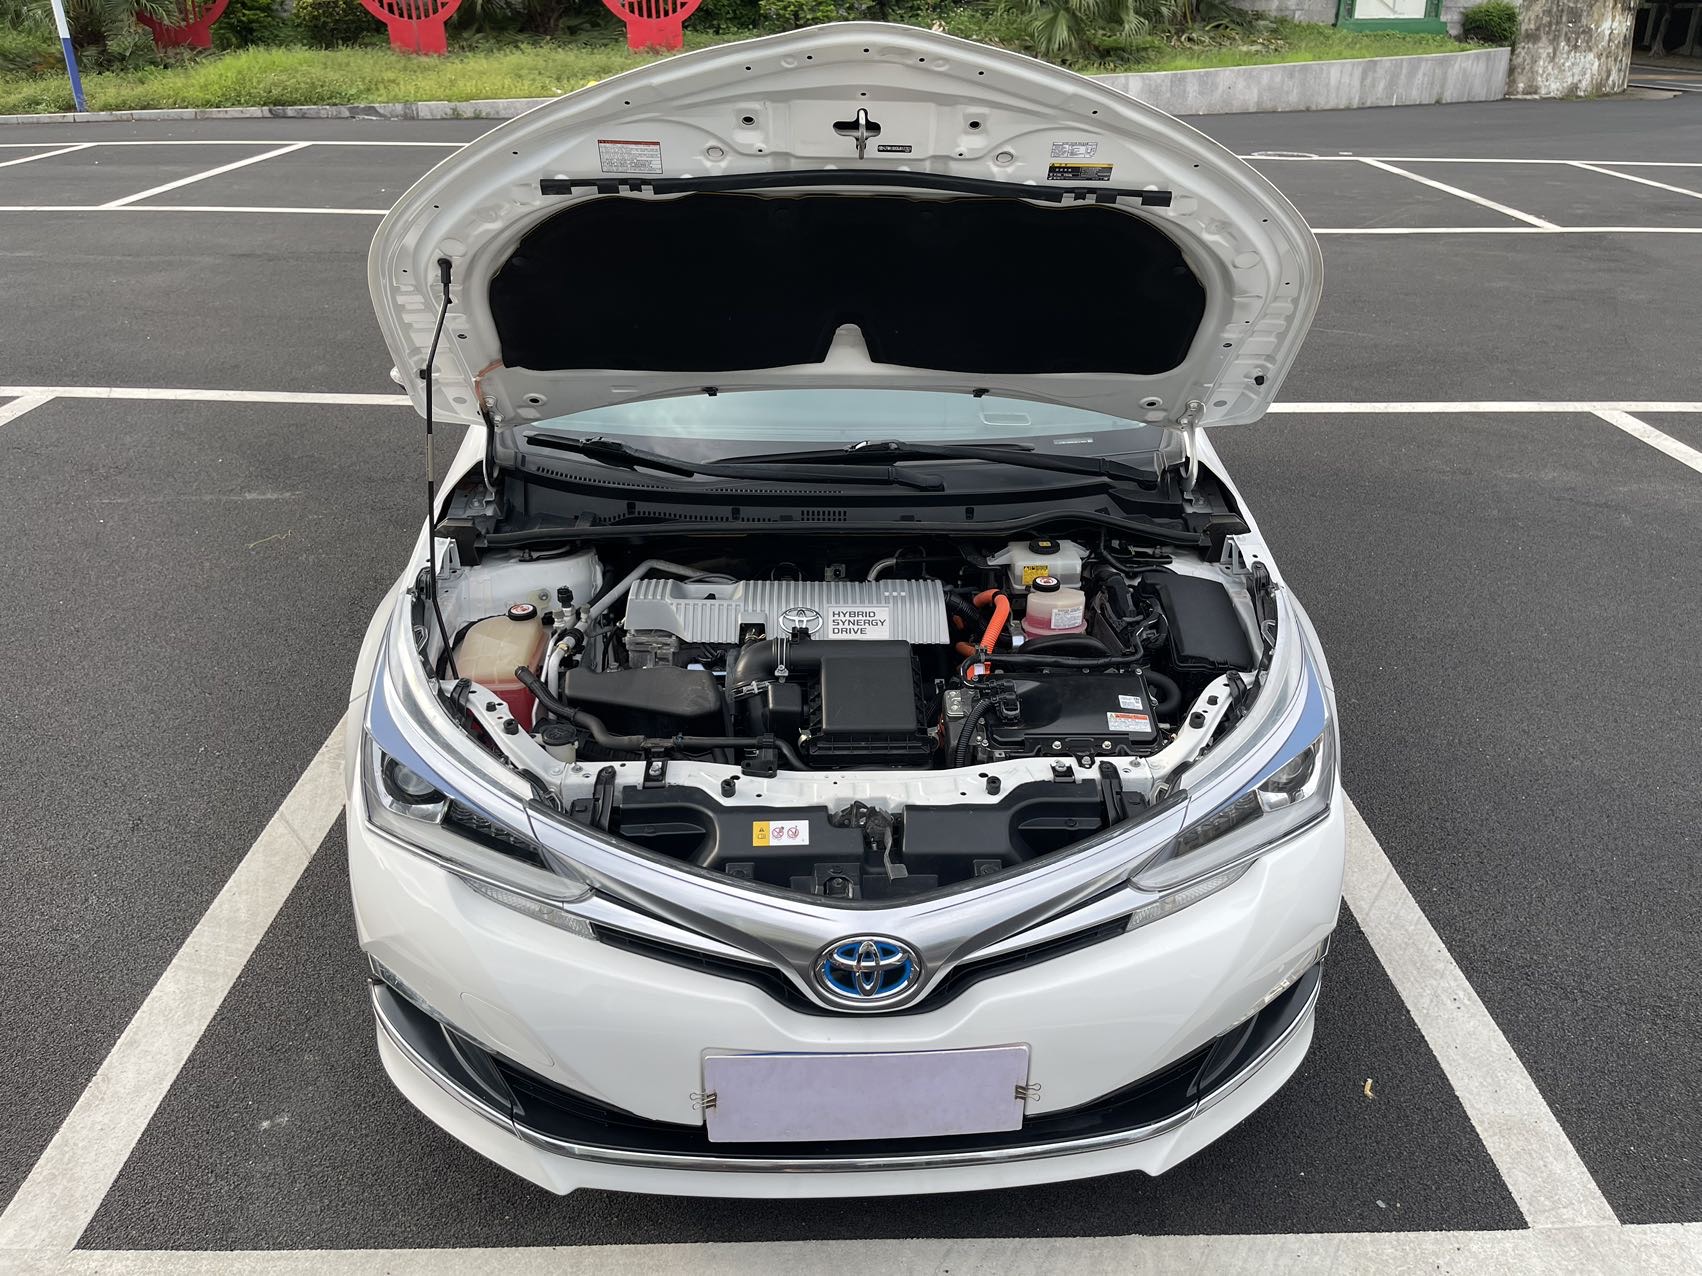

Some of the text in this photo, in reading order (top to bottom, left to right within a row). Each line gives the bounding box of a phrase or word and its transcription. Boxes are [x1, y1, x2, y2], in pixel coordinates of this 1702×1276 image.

[832, 610, 876, 618] HYBRID
[832, 619, 887, 627] SYNERGY
[832, 627, 868, 635] DRIVE
